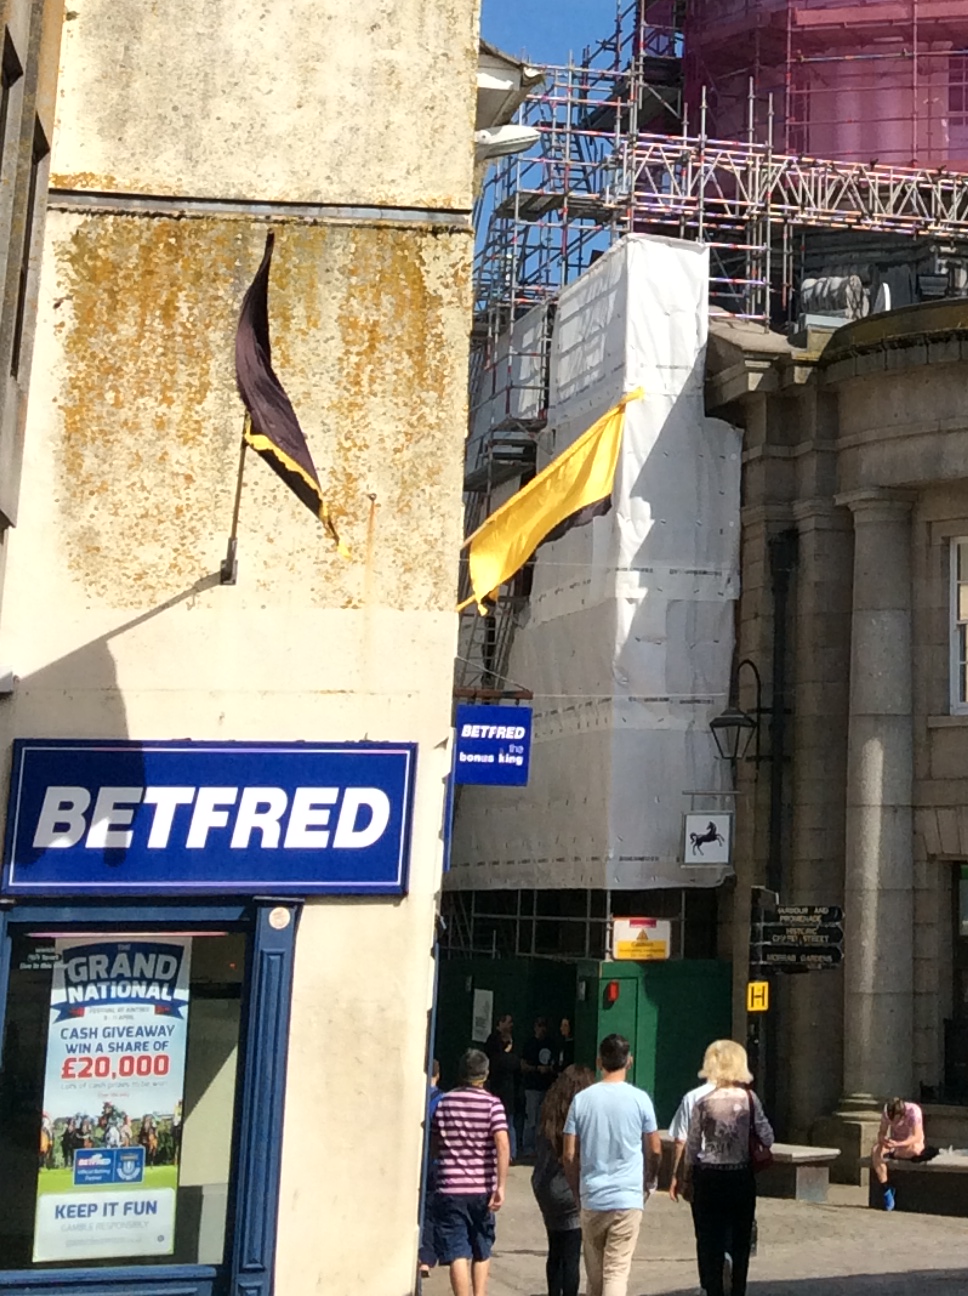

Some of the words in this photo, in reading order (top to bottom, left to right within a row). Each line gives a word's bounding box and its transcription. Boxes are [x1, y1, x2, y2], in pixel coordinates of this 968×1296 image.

[461, 724, 526, 740] BETFRED
[459, 751, 495, 763] bonus
[498, 752, 524, 766] king
[32, 787, 390, 849] BETFRED
[66, 952, 178, 984] GRAND
[67, 980, 173, 1004] NATIONAL
[750, 985, 766, 1008] H
[60, 1027, 98, 1040] CASH
[102, 1024, 176, 1039] GIVEAWAY
[65, 1042, 92, 1054] WIN
[95, 1042, 104, 1053] A
[108, 1041, 149, 1053] SHARE
[153, 1040, 170, 1051] OF
[61, 1054, 170, 1080] £20,000
[55, 1203, 98, 1220] KEEP
[103, 1202, 119, 1217] IT
[123, 1200, 158, 1216] FUN
